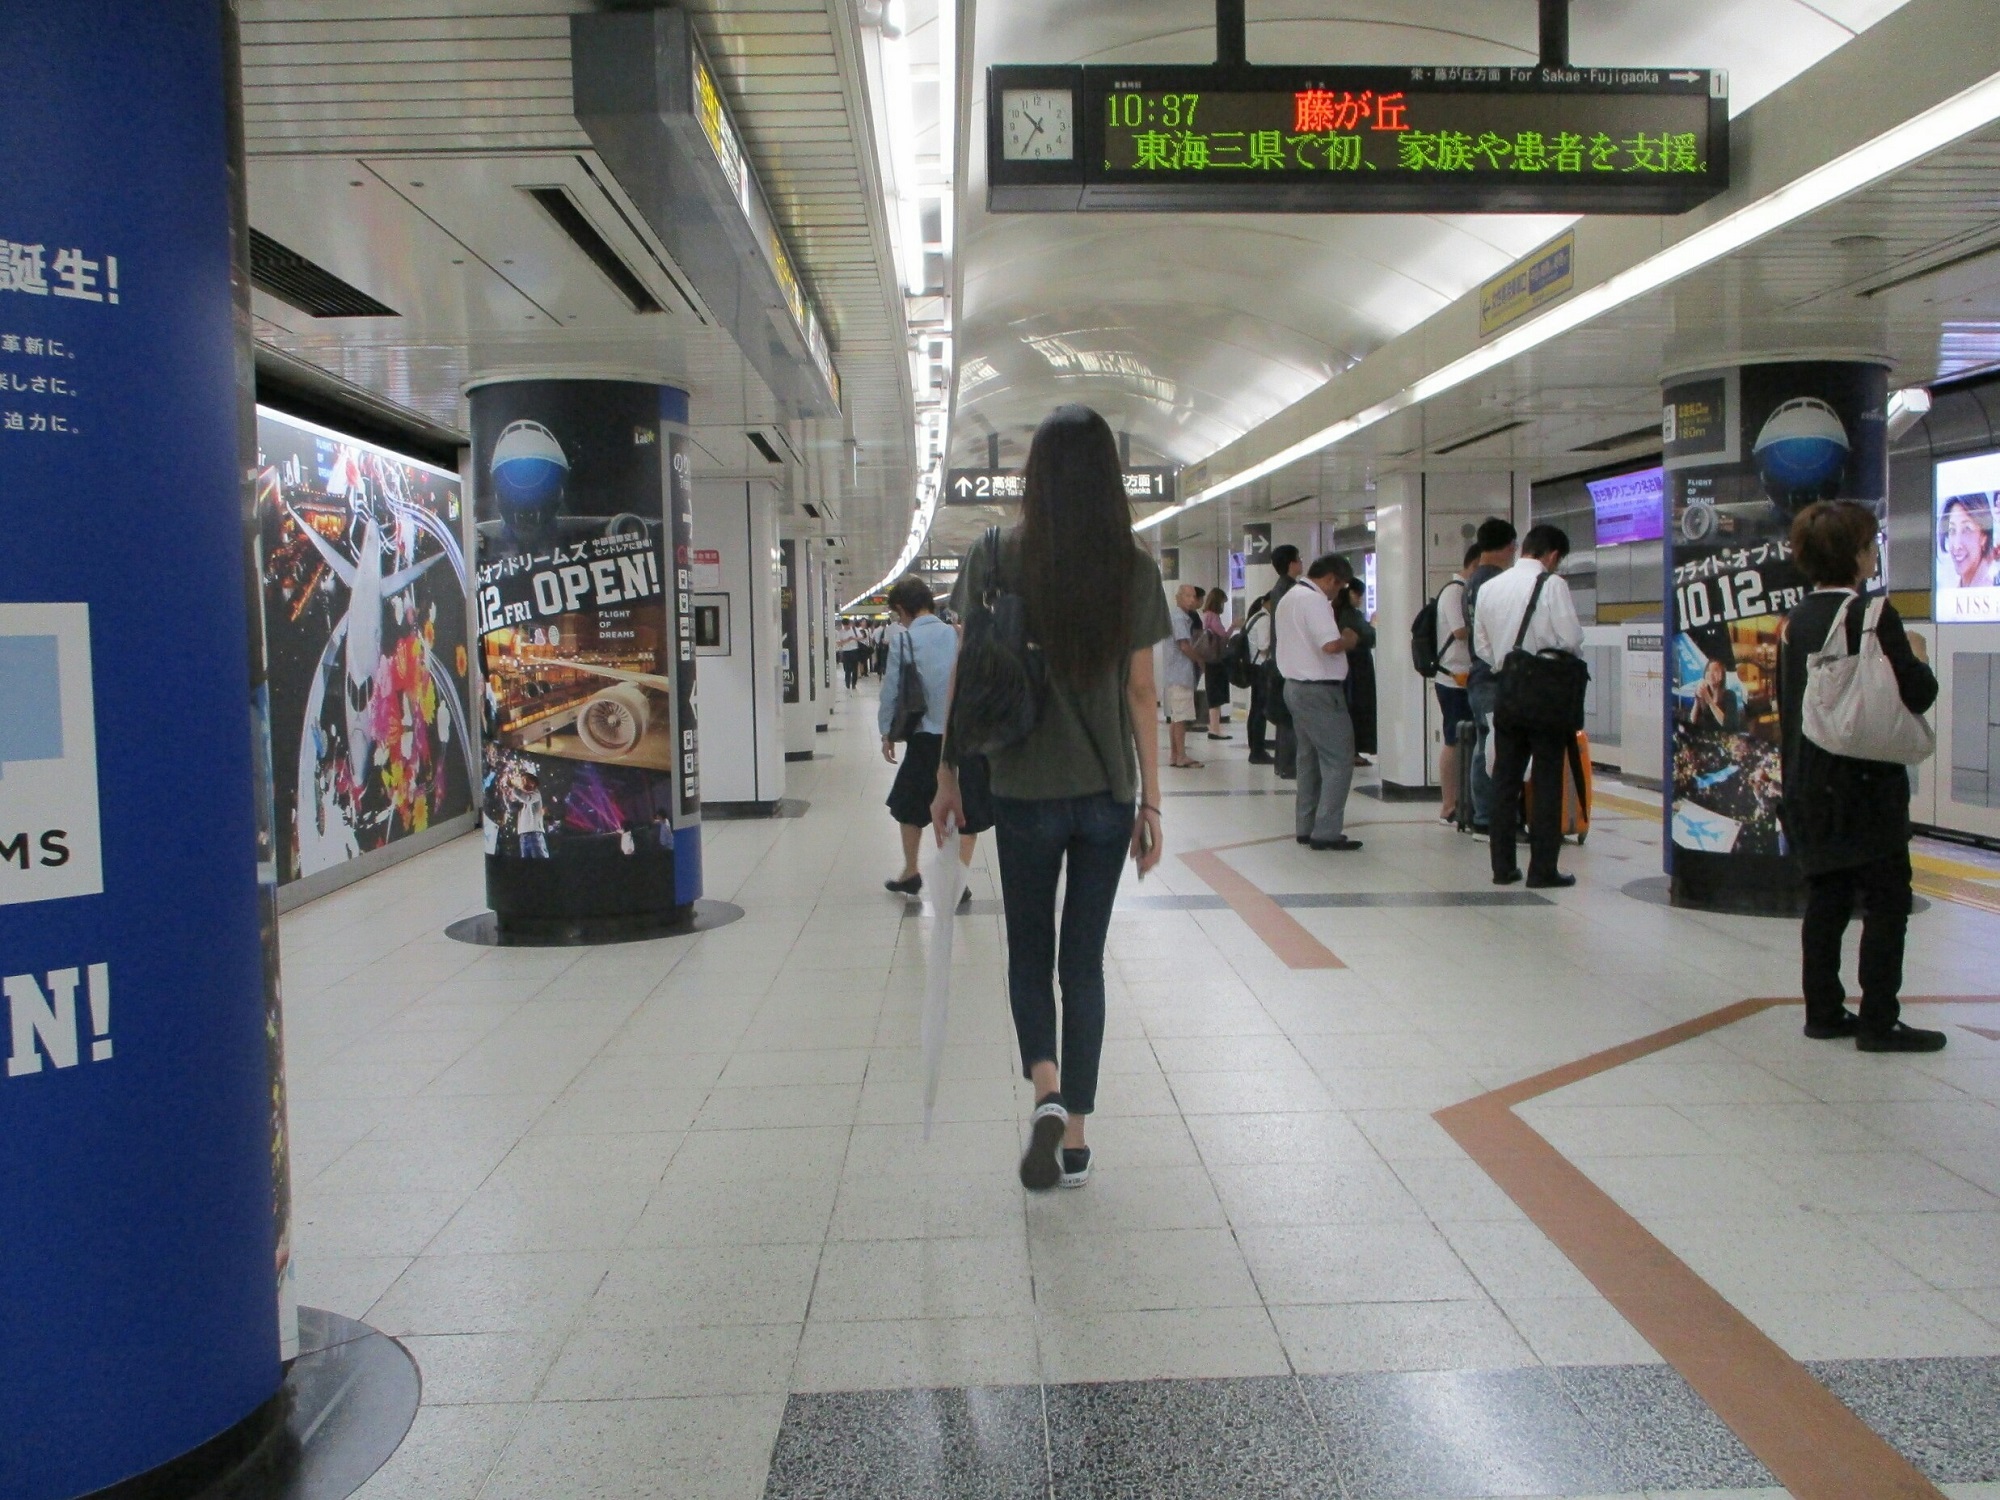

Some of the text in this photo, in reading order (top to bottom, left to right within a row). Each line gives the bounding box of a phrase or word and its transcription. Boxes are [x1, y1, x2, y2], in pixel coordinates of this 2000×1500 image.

[1510, 69, 1532, 82] For
[1108, 93, 1199, 127] 10:37
[1295, 90, 1410, 132] 藤が丘
[1, 333, 75, 360] 革新に。
[4, 411, 79, 434] 迫力に。
[975, 476, 990, 497] 2
[1154, 474, 1163, 494] 1
[932, 558, 939, 570] 2
[504, 601, 532, 625] FRI
[532, 551, 660, 616] OPEN!
[1676, 570, 1767, 631] 10.12
[1955, 596, 1991, 615] KISS
[598, 610, 630, 618] FLIGHT
[599, 631, 635, 639] DREAMS
